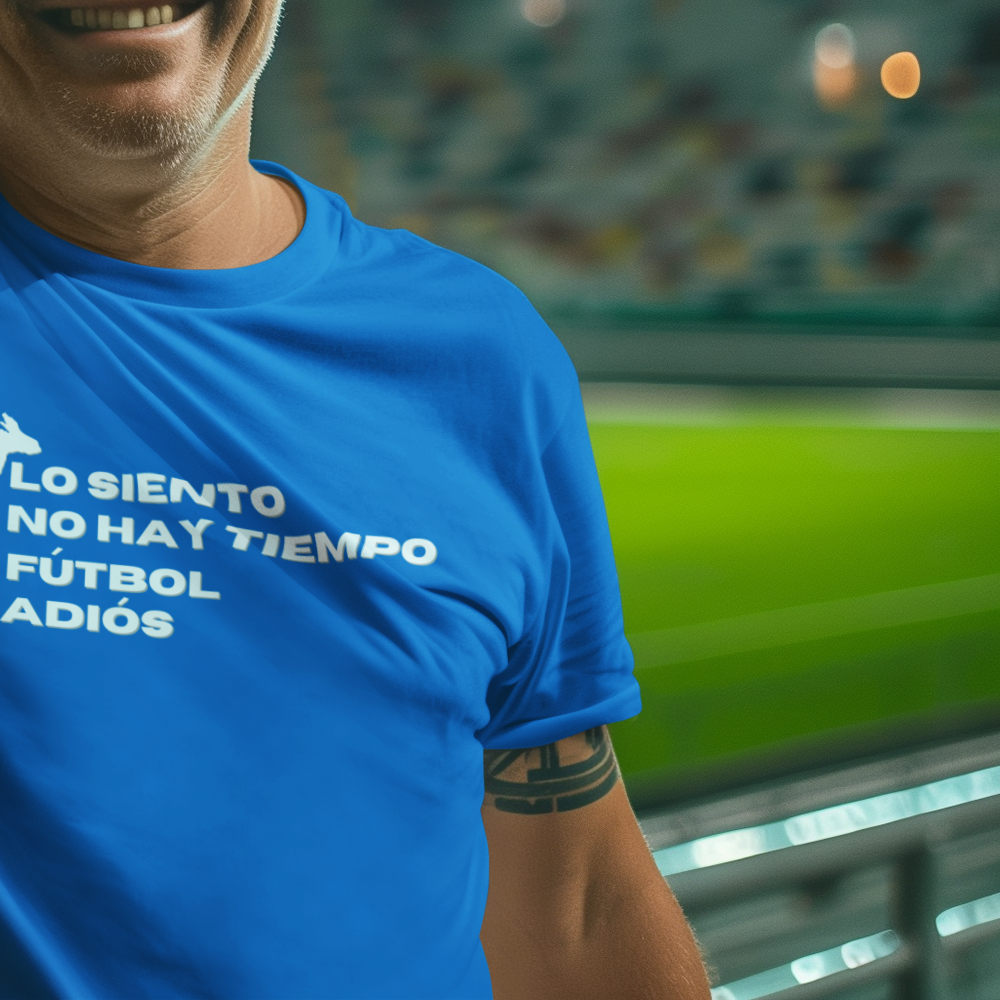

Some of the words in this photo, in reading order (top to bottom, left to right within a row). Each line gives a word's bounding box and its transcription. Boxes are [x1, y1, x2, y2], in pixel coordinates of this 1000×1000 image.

[9, 461, 78, 495] LO
[87, 471, 286, 518] SIENTO
[6, 504, 87, 539] NO
[97, 514, 214, 550] HAY
[224, 525, 437, 566] TIEMPO
[6, 547, 221, 600] FÚTBOL
[0, 596, 174, 639] ADIÓS
